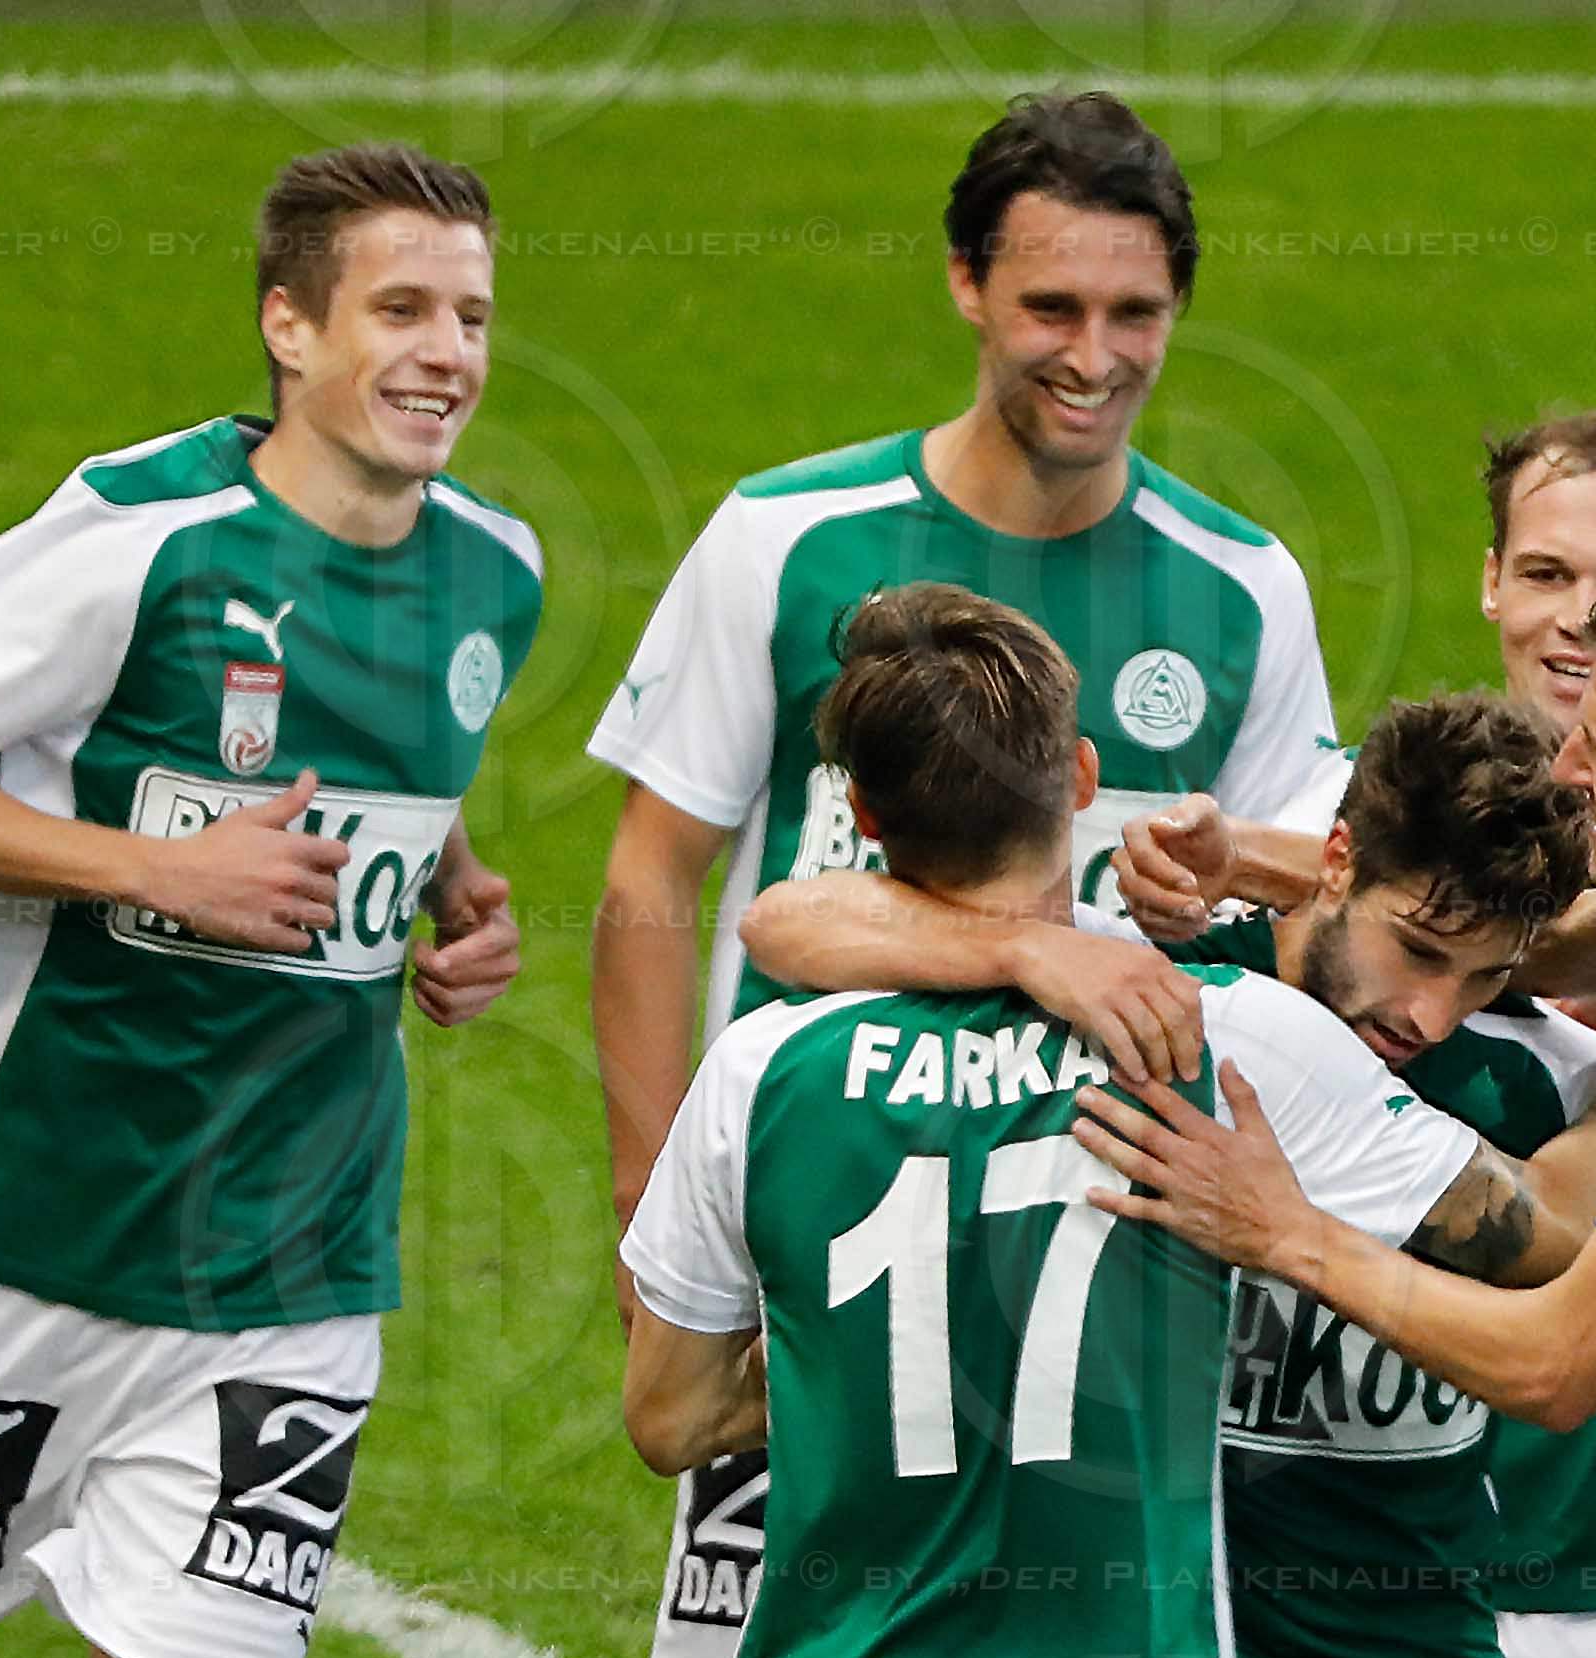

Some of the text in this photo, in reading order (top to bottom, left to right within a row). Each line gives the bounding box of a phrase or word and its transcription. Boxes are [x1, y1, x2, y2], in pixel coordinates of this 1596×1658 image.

[843, 1019, 1110, 1110] FARKA
[827, 1133, 1132, 1478] 17
[204, 1519, 332, 1603] DAC
